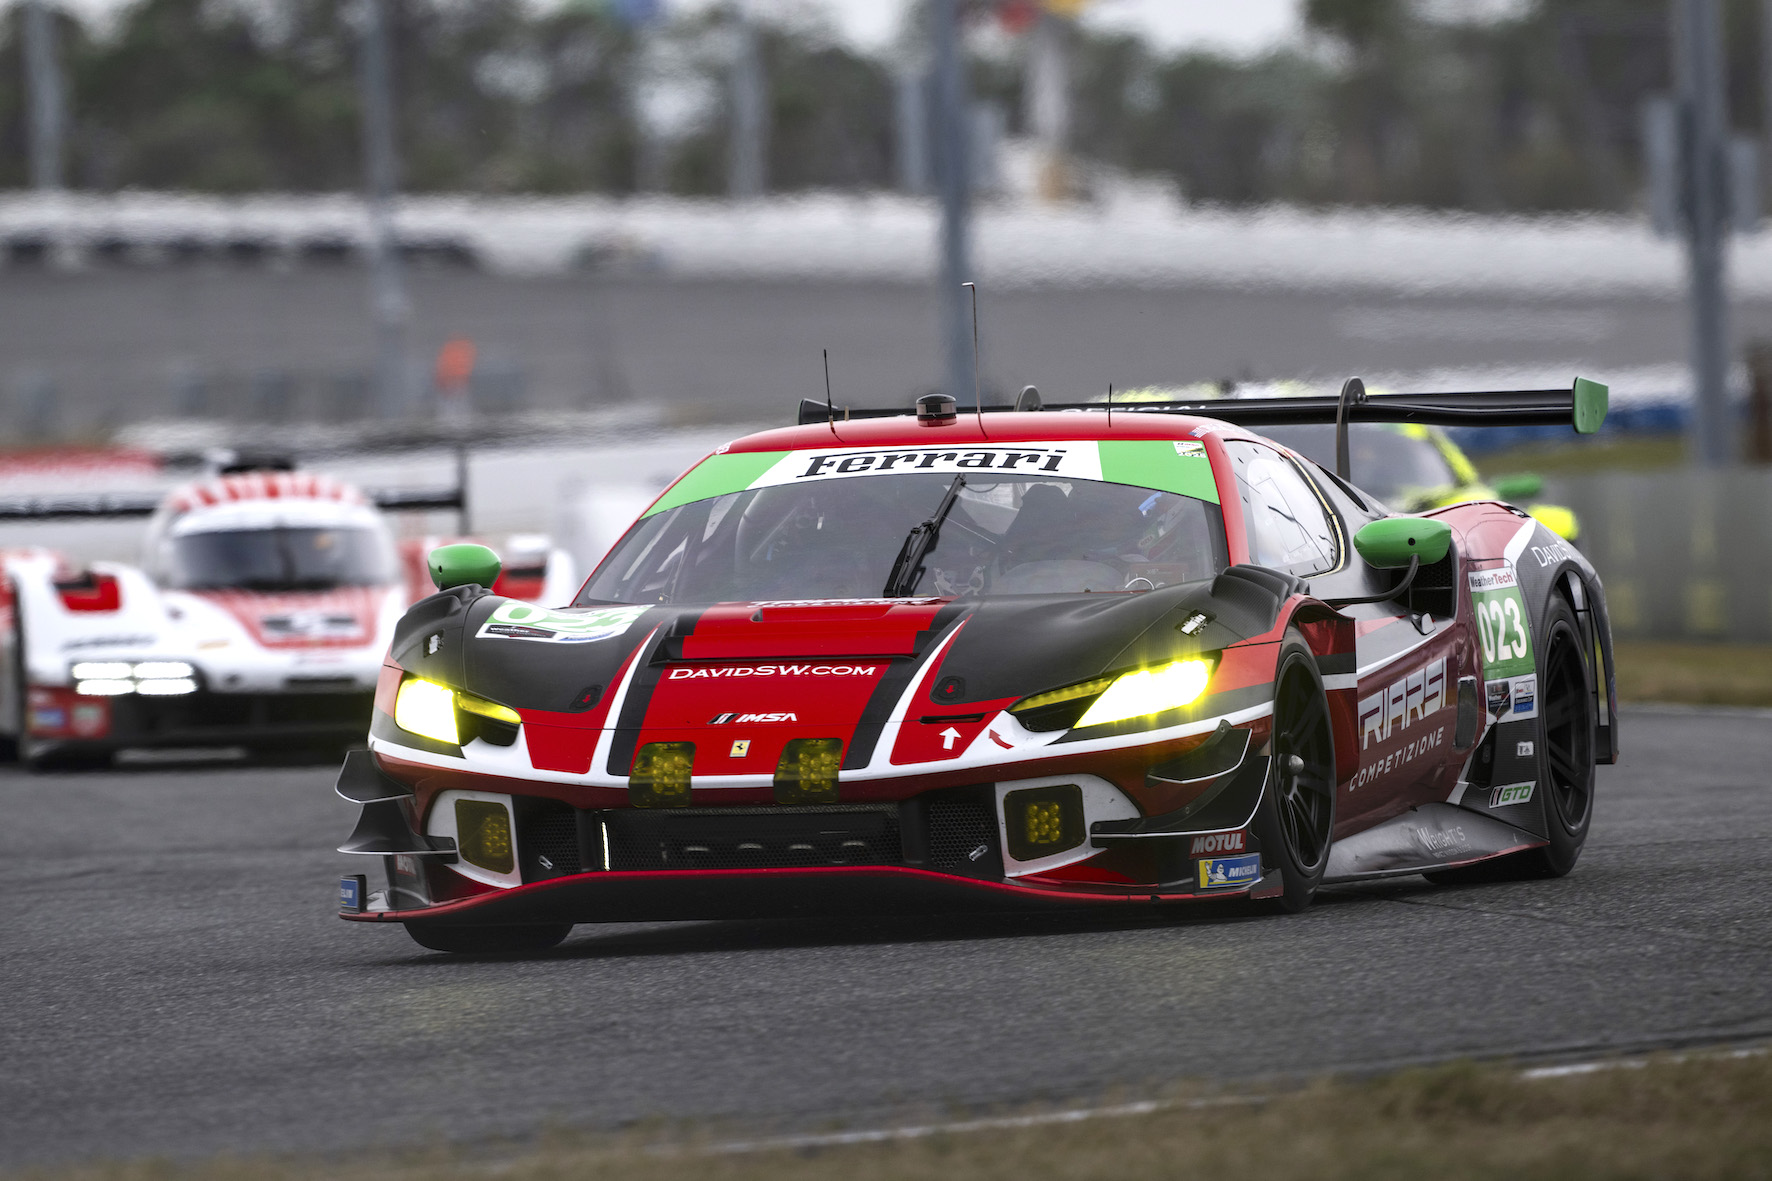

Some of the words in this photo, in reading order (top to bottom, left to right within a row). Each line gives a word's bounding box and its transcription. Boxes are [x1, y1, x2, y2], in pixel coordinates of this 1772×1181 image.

[796, 447, 1067, 479] Ferrari
[1470, 571, 1514, 588] WeatherTech
[1477, 597, 1527, 663] 023
[668, 665, 876, 680] DAVIDSW.COM
[1357, 656, 1447, 751] RIARSI
[735, 713, 797, 723] IMSA
[1349, 726, 1445, 792] COMPETIZIONE
[1501, 785, 1531, 802] GTD
[1191, 833, 1244, 854] MOTUL
[1228, 864, 1258, 878] MICHELIN
